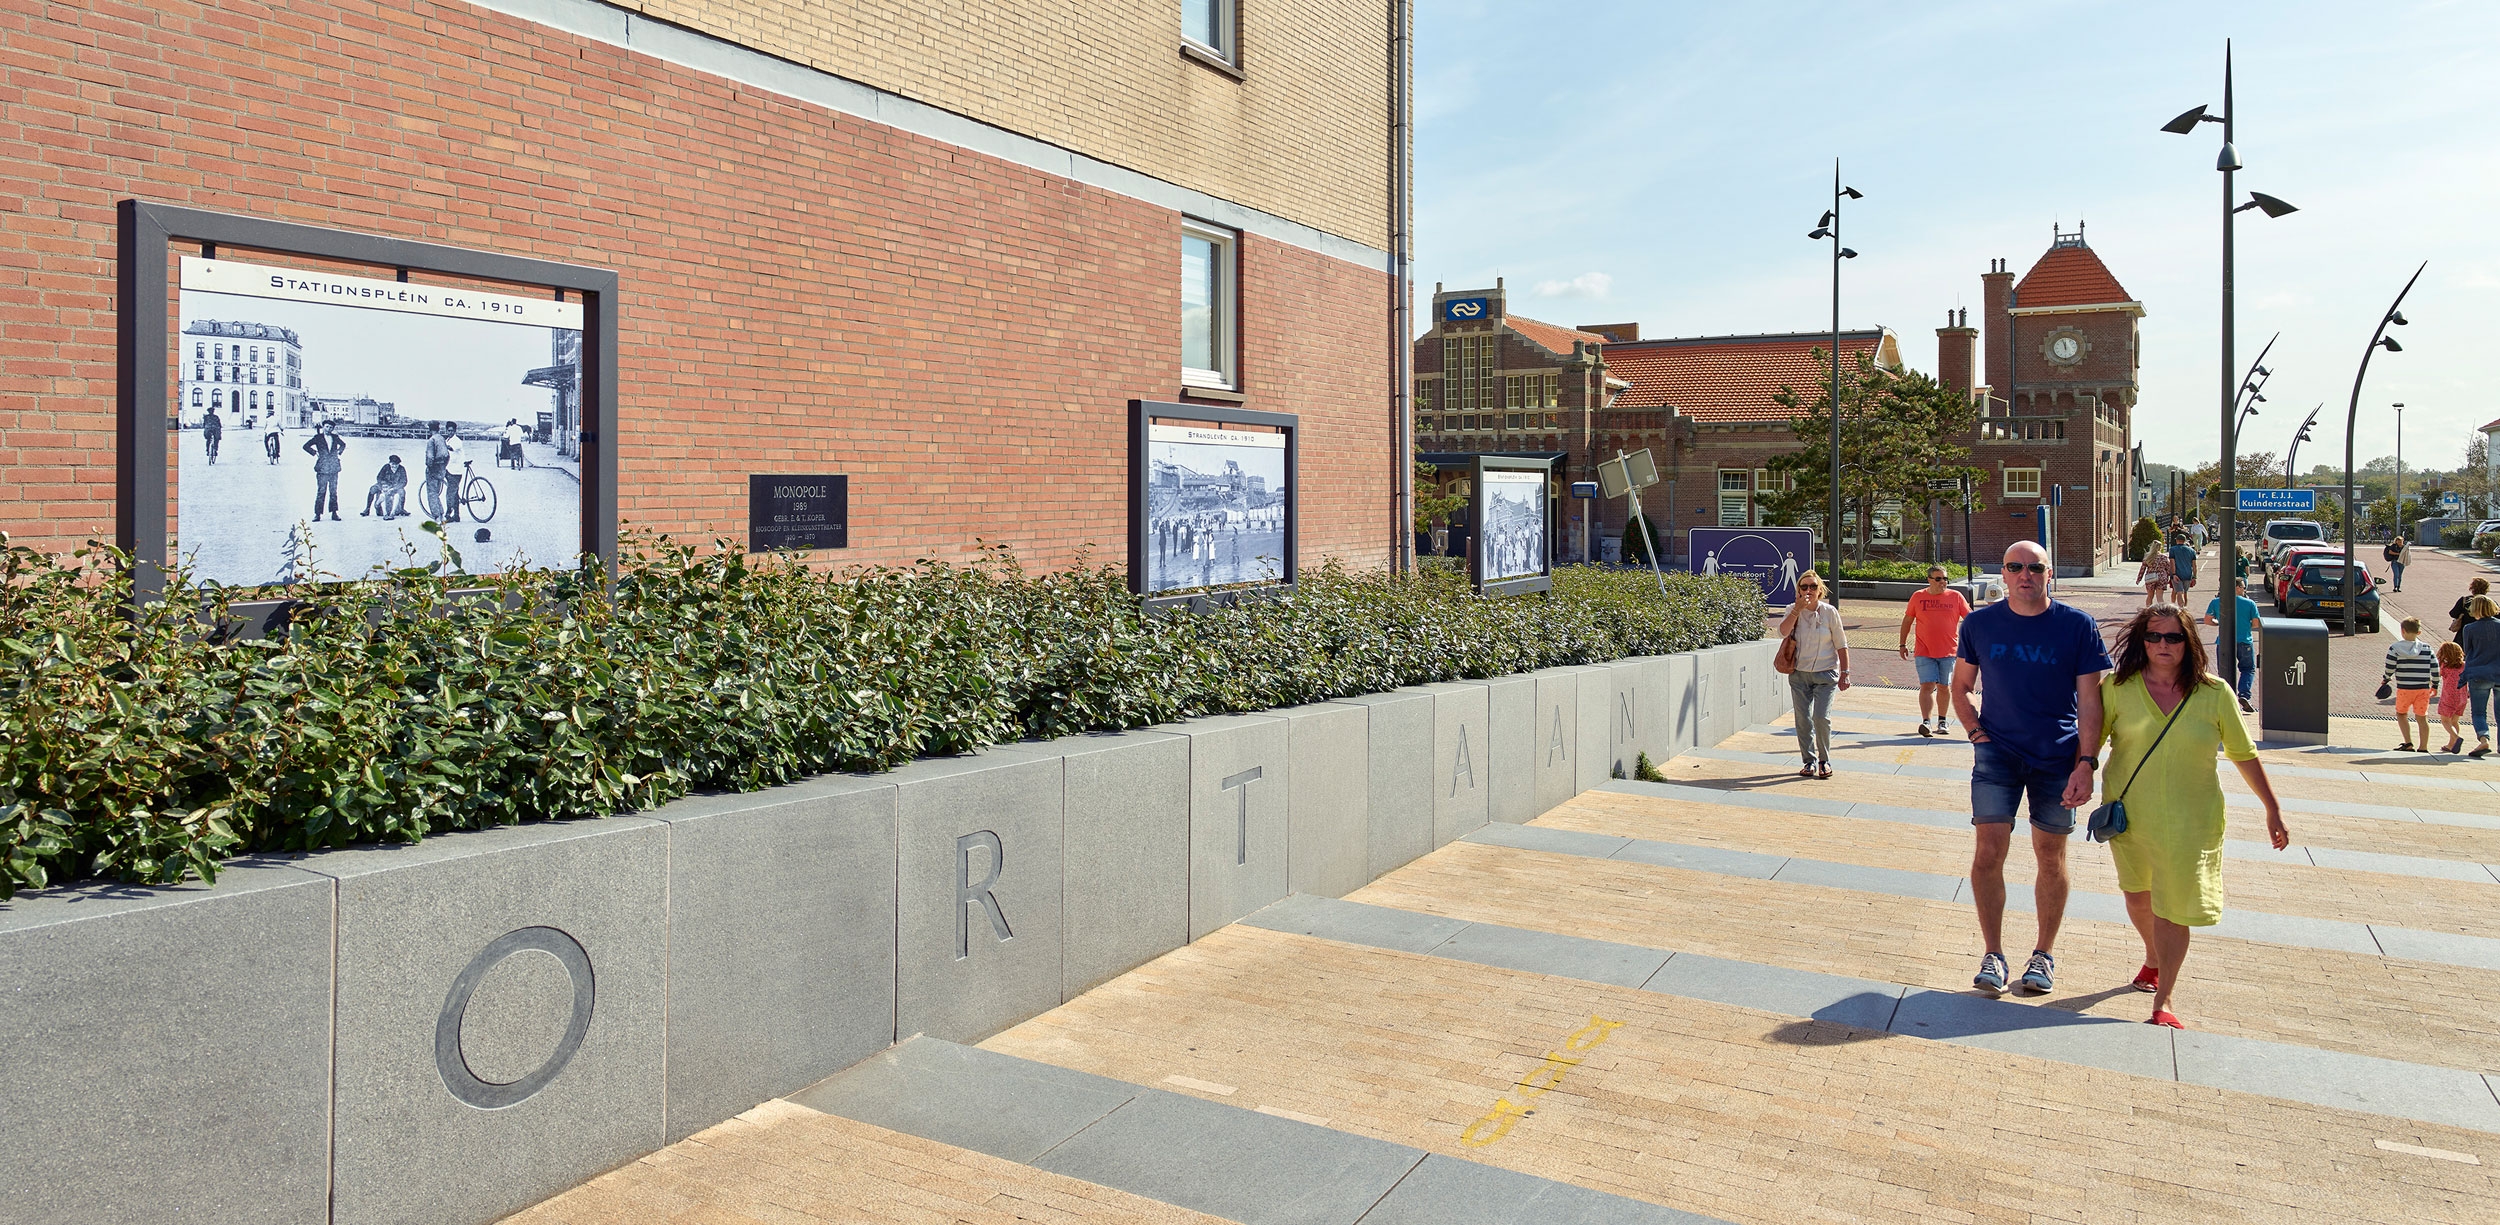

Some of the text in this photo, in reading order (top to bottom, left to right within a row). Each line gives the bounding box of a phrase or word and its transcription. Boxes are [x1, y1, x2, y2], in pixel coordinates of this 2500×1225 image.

[481, 301, 523, 315] 1910
[773, 485, 827, 498] MONOPOLE
[2258, 491, 2269, 499] Ir.
[2241, 500, 2310, 508] Kuindersstraat
